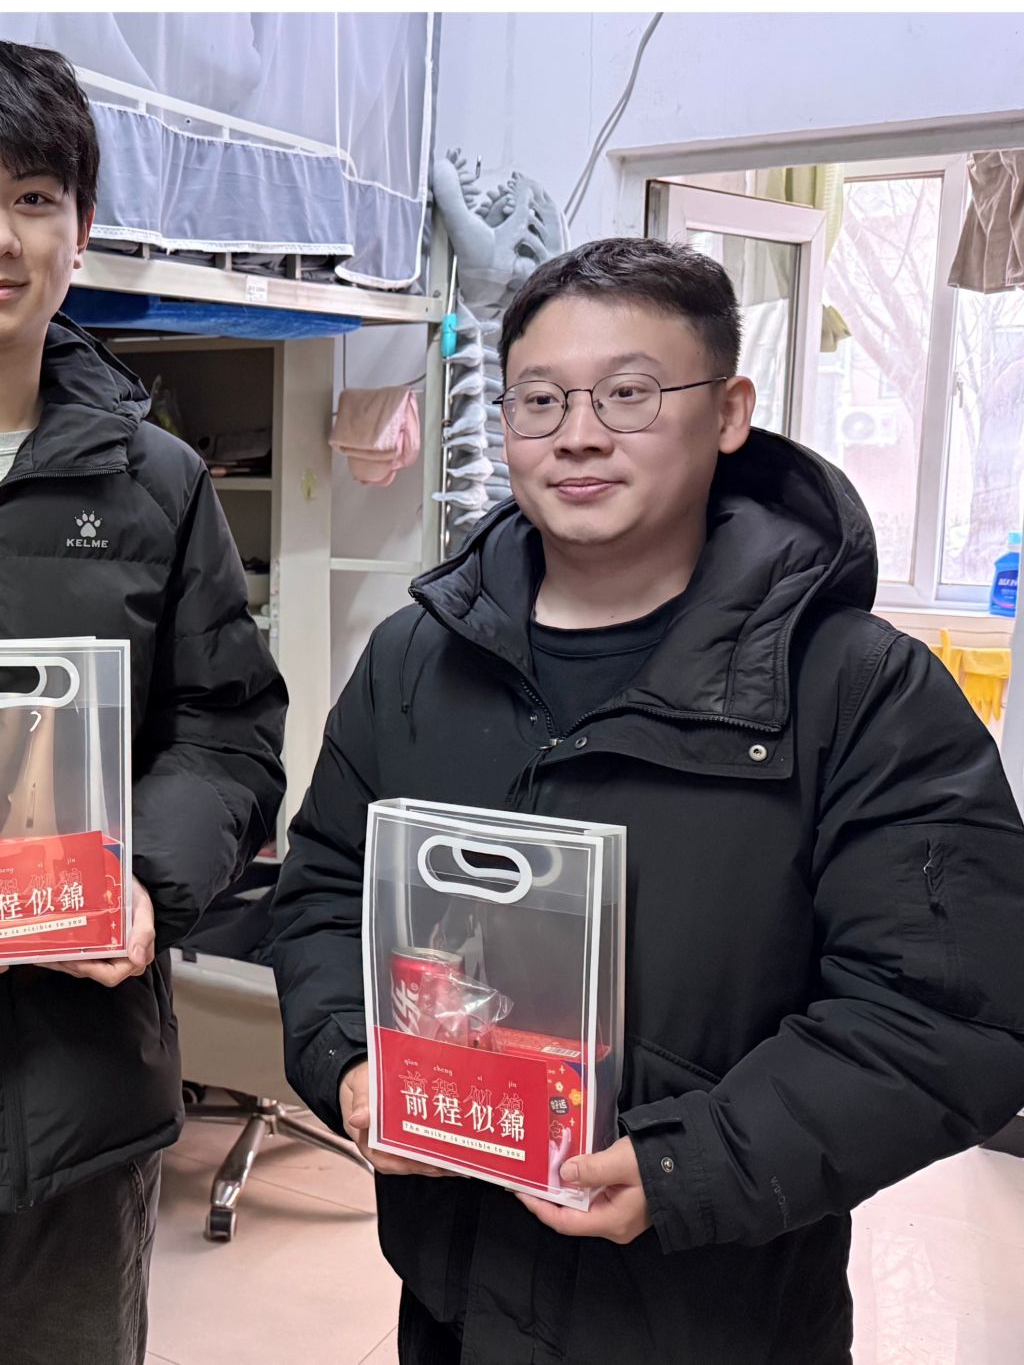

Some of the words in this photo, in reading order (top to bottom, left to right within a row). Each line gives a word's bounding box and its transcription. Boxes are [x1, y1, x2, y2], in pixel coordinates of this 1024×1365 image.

[66, 539, 109, 548] KELME
[433, 1065, 453, 1076] cheng
[400, 1086, 525, 1142] 前程似錦
[404, 1122, 420, 1132] The
[462, 1138, 491, 1150] visible
